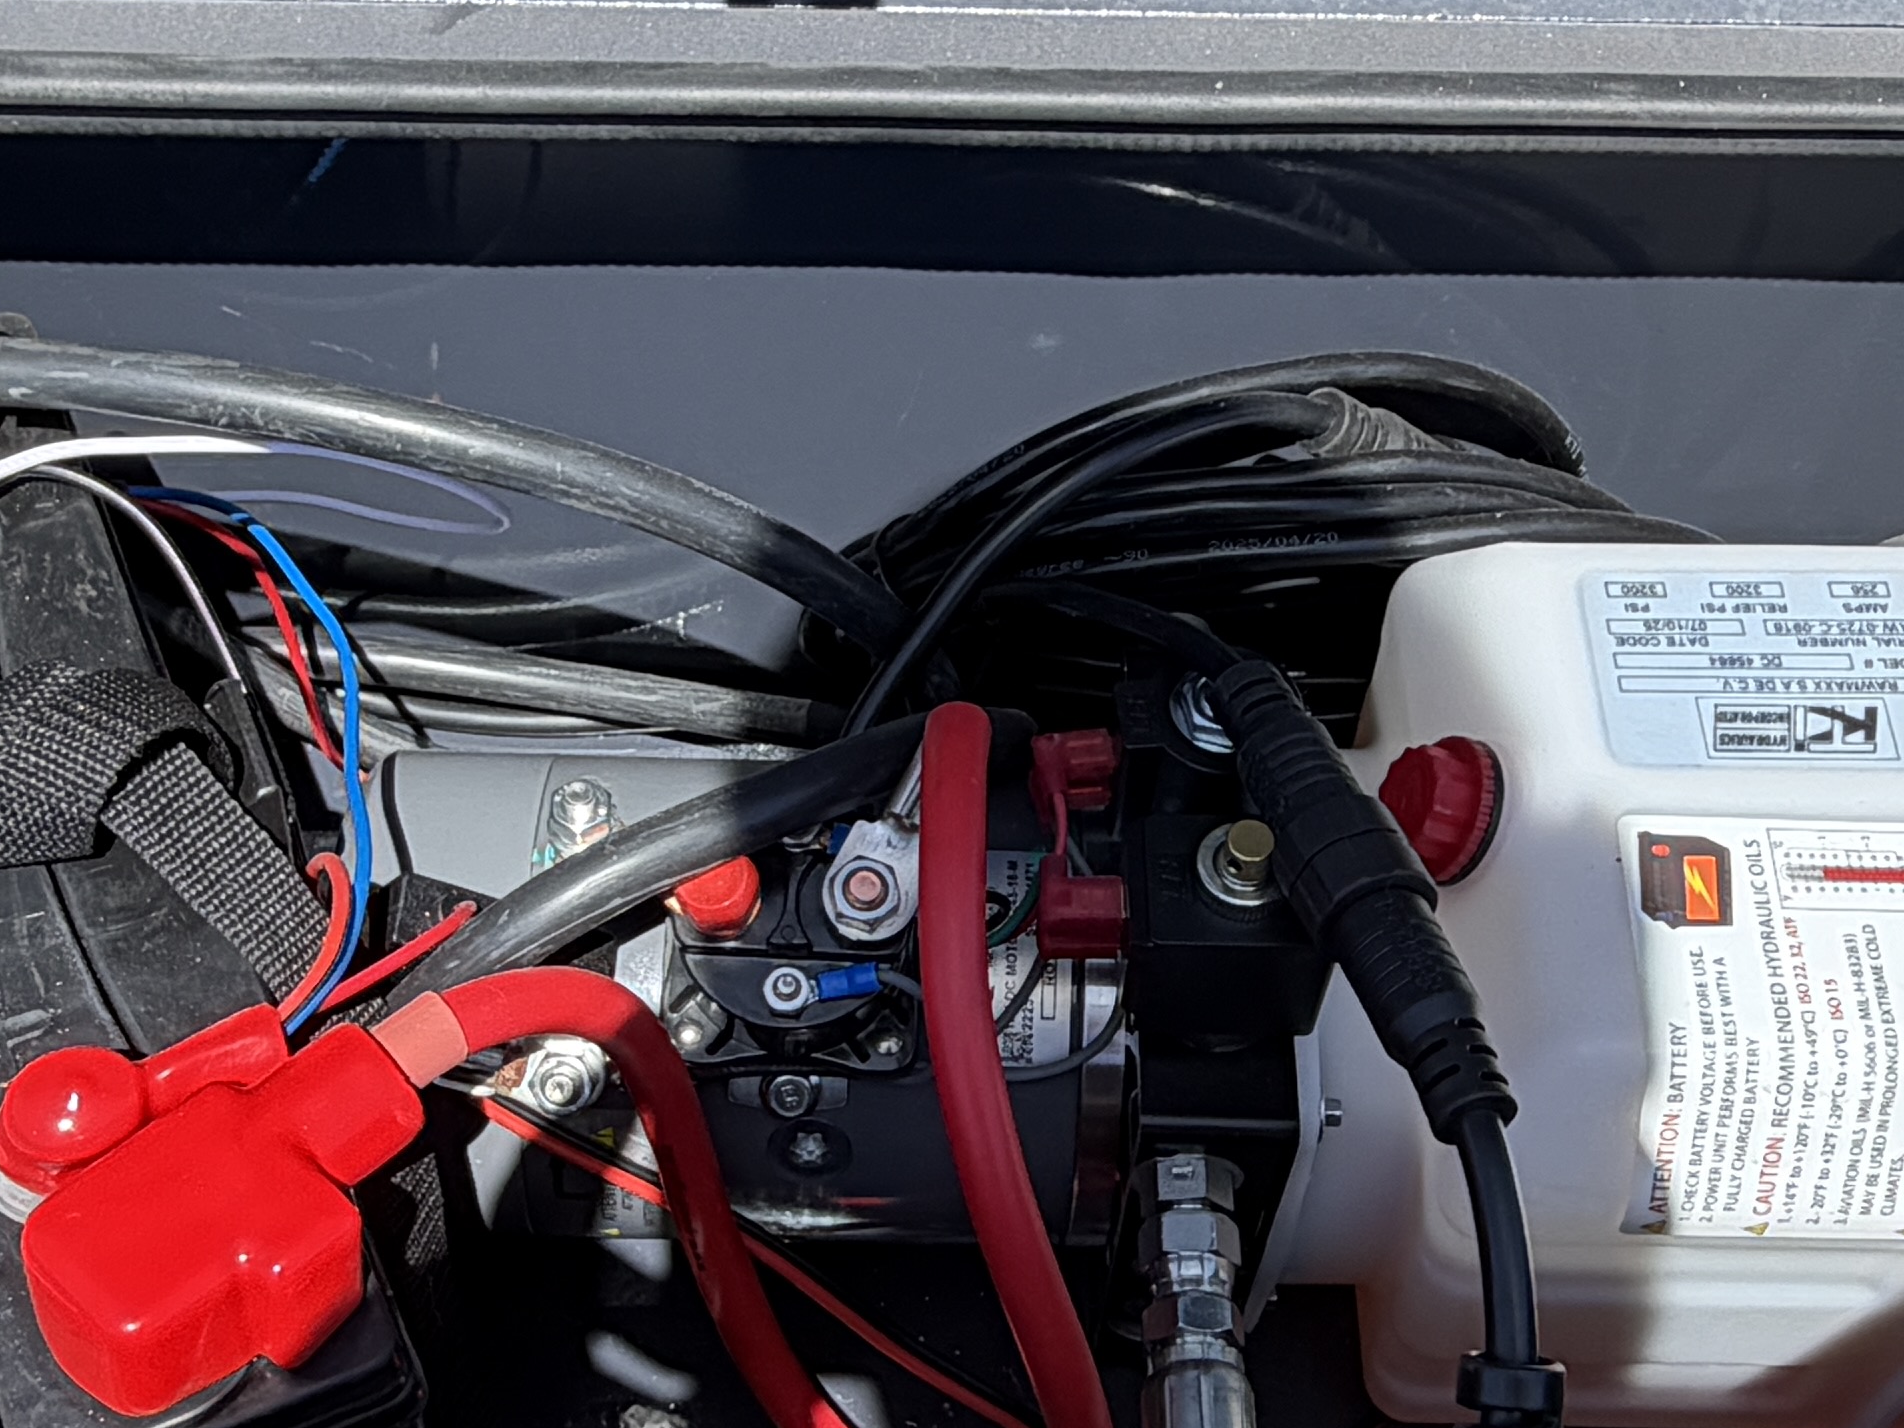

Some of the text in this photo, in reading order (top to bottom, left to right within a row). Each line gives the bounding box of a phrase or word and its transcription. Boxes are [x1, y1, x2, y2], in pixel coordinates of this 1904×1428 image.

[1624, 603, 1650, 613] PSI
[1700, 603, 1787, 613] RELIEF PSI
[1842, 603, 1888, 613] AMPS
[1614, 636, 1709, 646] DATE CODE
[1797, 637, 1867, 646] NUMBER
[1713, 957, 1724, 966] A
[1695, 981, 1715, 1034] BEFORE
[1715, 971, 1732, 1007] WITH
[1721, 1012, 1737, 1046] BEST
[1743, 839, 1795, 1216] CAUTION: RECOMMENDED HYDRAULIC OILS
[1699, 1041, 1716, 1105] VOLTAGE
[1716, 1052, 1739, 1128] PERFORMS
[1859, 924, 1899, 1215] MAY BE USED IN PROLONGED EXTREME COLD
[1648, 1022, 1687, 1213] ATTENTION: BATTERY
[1688, 1110, 1710, 1166] BATTERY
[1723, 1037, 1759, 1212] FULLY CHARGED BATTERY
[1790, 1166, 1802, 1178] to
[1807, 1062, 1818, 1076] to
[1817, 1168, 1830, 1179] to
[1834, 1072, 1847, 1086] to
[1712, 1133, 1727, 1163] UNIT
[1849, 1128, 1867, 1156] OILS
[1681, 1171, 1700, 1212] CHECK
[1702, 1167, 1722, 1211] POWER
